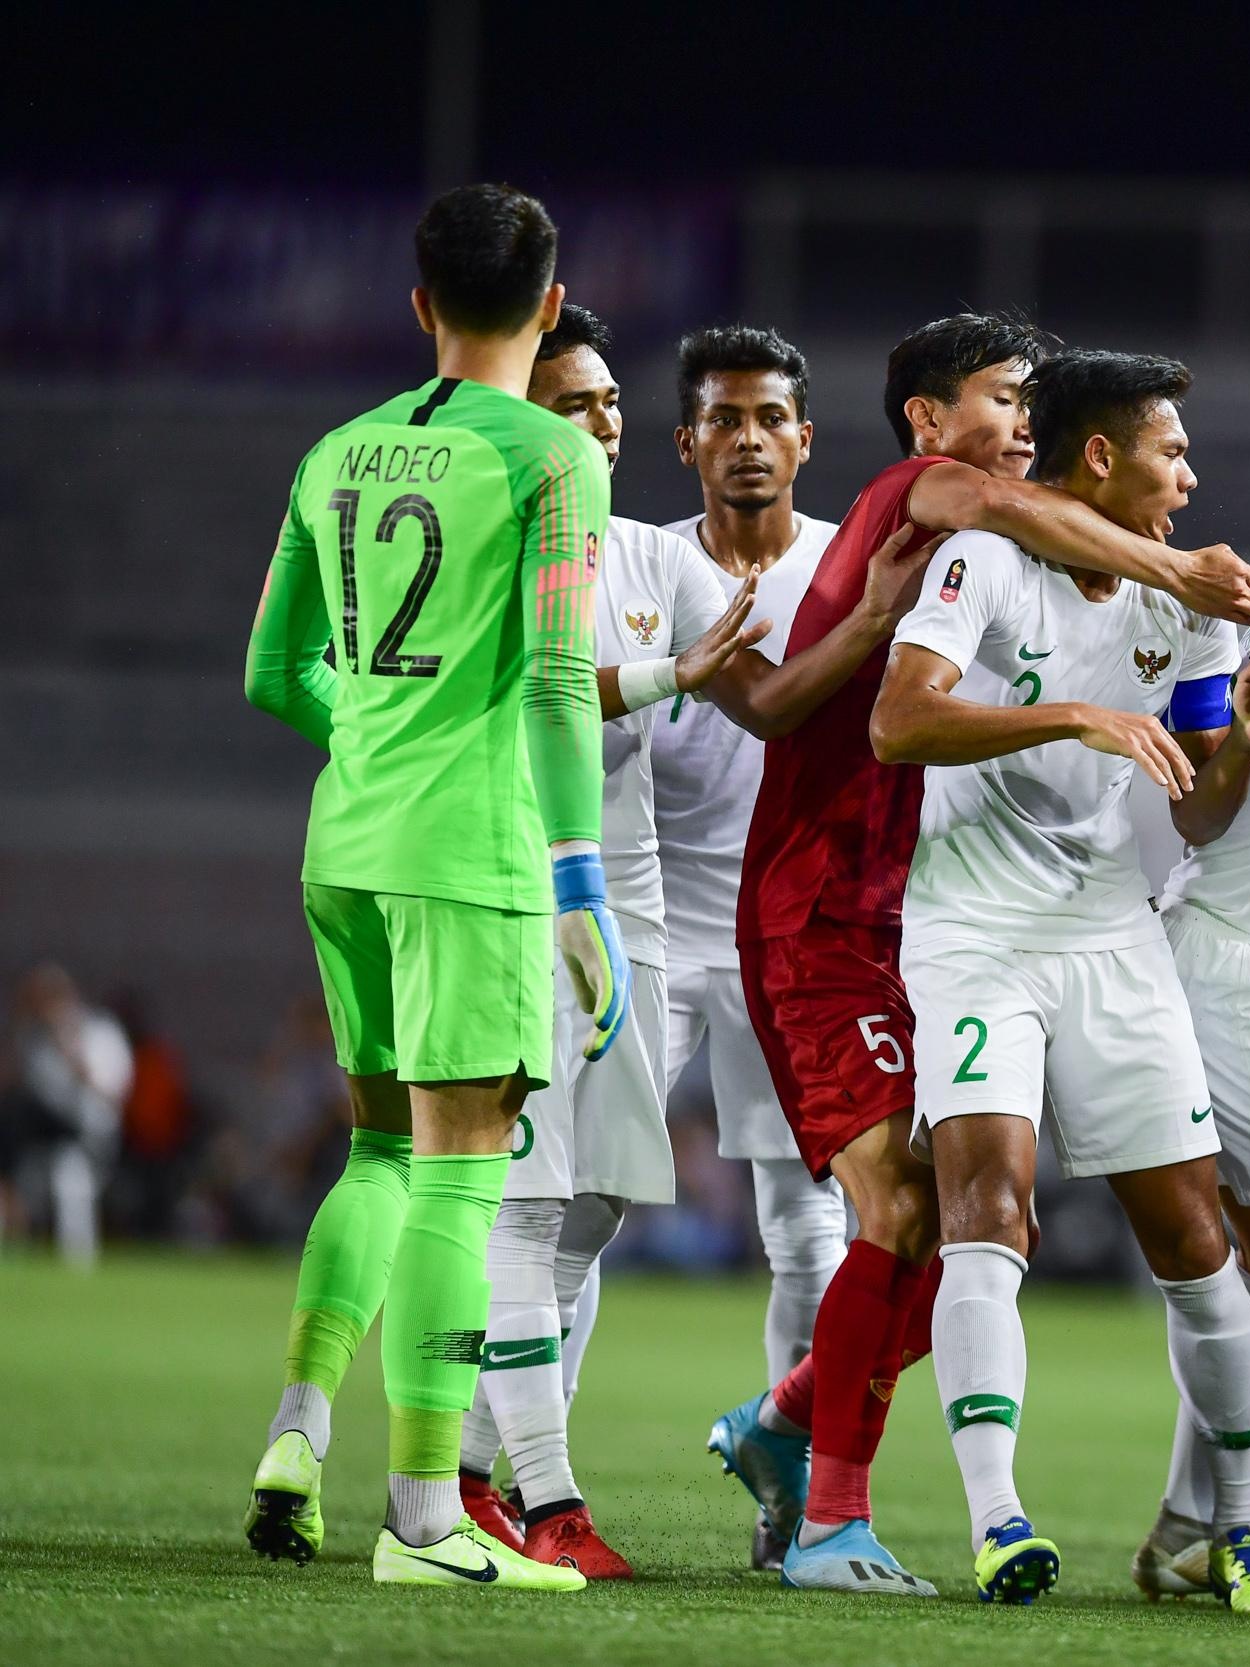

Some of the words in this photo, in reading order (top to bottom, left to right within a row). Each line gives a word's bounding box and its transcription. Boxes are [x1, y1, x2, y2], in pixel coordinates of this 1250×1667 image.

[337, 444, 451, 482] NADEO
[327, 489, 443, 677] 12
[857, 1014, 906, 1074] 5
[952, 1016, 989, 1084] 2
